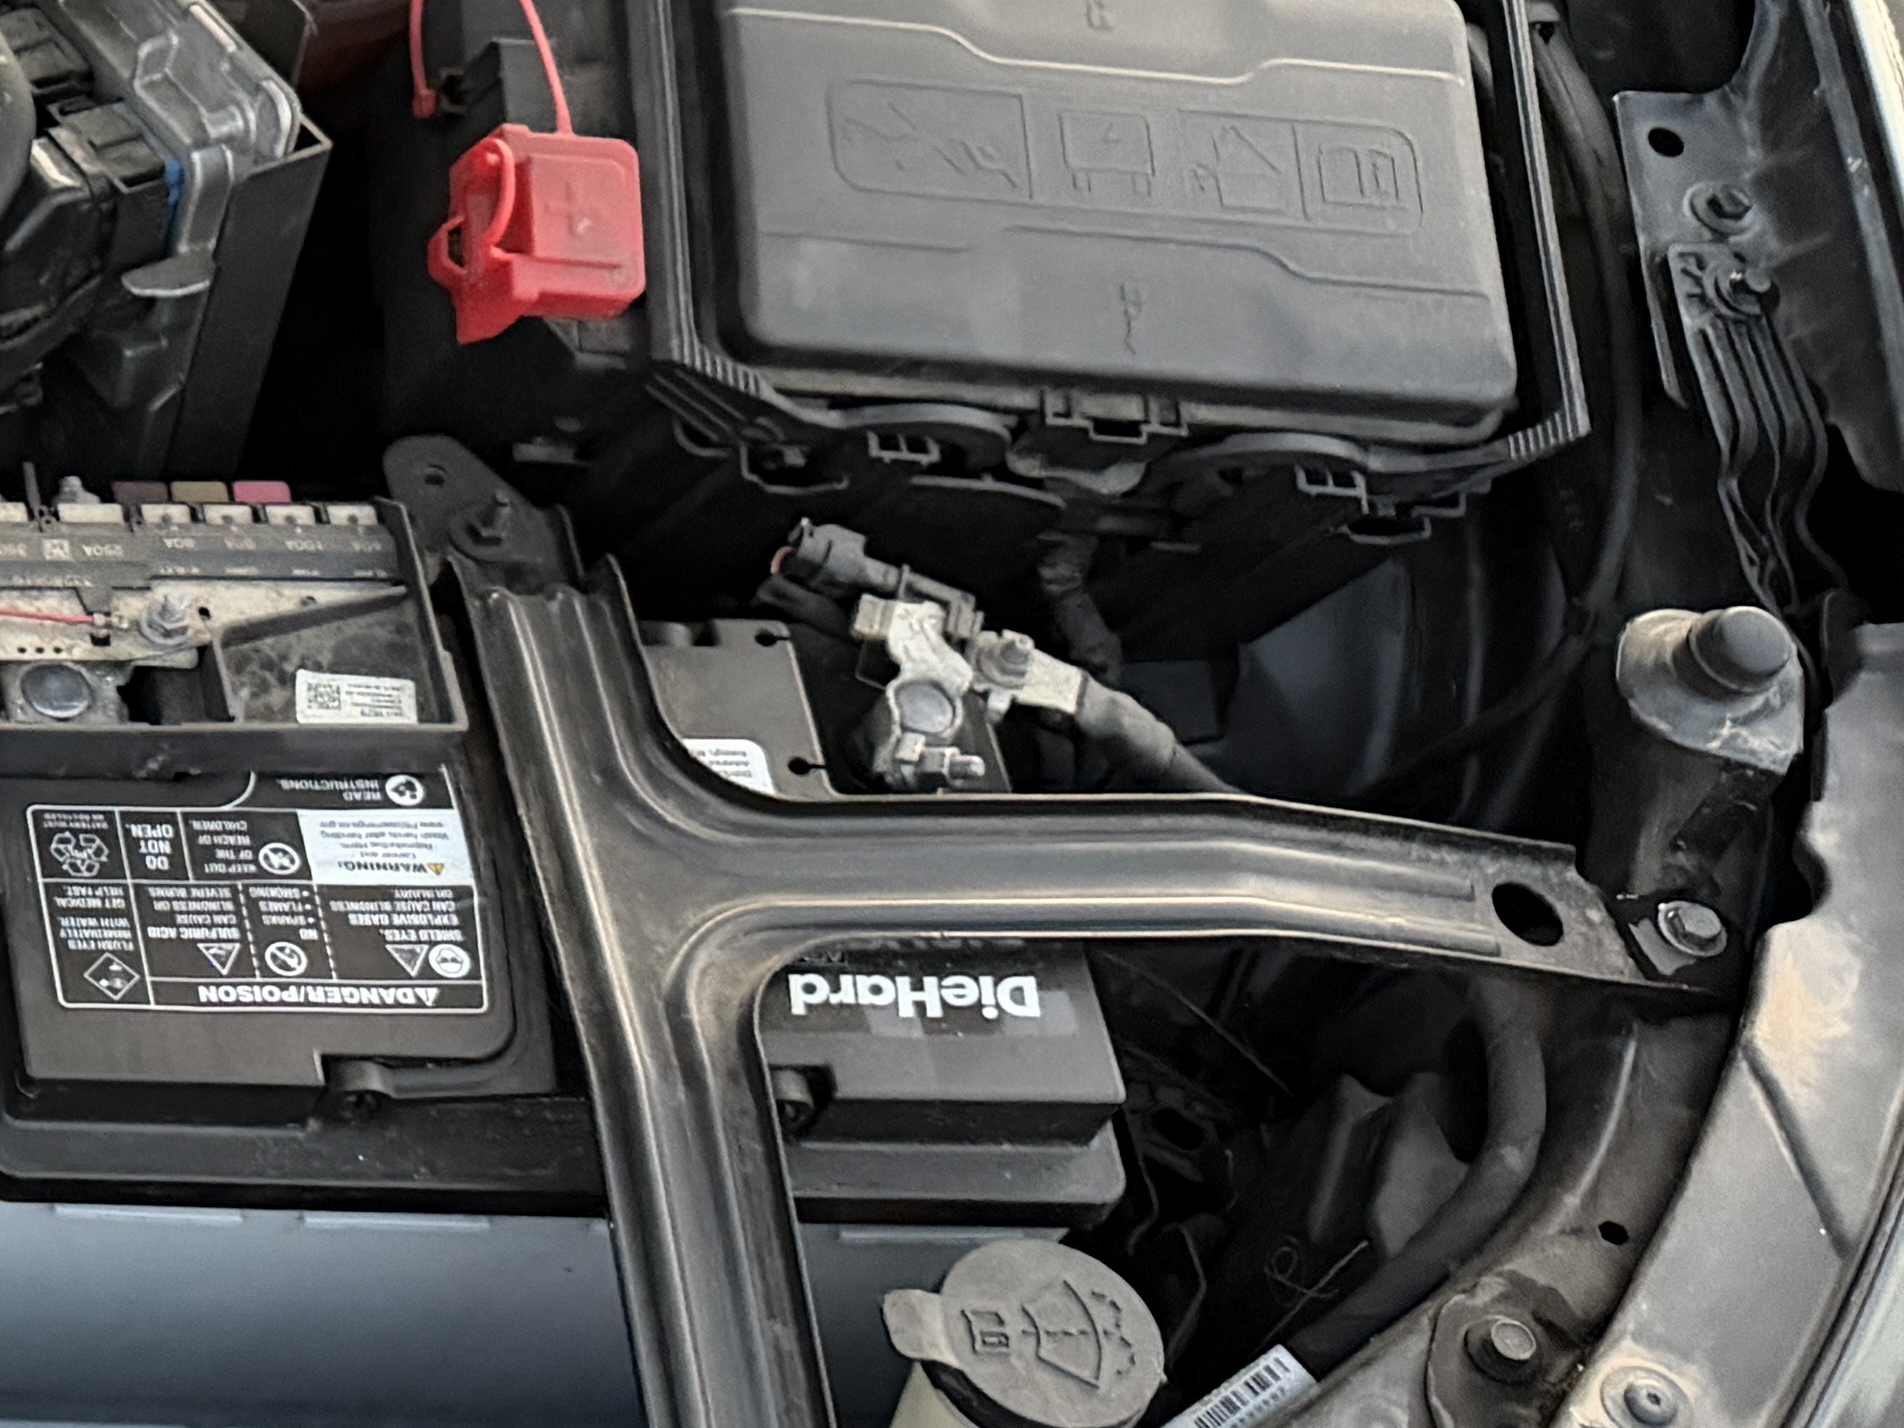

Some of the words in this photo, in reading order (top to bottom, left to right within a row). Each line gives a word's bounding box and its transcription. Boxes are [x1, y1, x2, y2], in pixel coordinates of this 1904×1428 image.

[342, 790, 383, 801] READ
[124, 823, 174, 839] OPEN.
[138, 839, 172, 854] NOT
[145, 855, 169, 870] DO
[337, 860, 428, 874] WARNING:
[393, 901, 430, 912] CAUSE
[431, 901, 456, 912] CAN
[100, 918, 130, 928] WITH
[175, 913, 211, 925] CAUSE
[213, 914, 237, 925] CAN
[392, 914, 459, 926] EXPLOSIVE
[146, 926, 178, 939] ACID
[419, 928, 464, 942] SHIELD
[197, 985, 416, 1005] DANGER/POISON
[788, 973, 1041, 1020] DieHard
